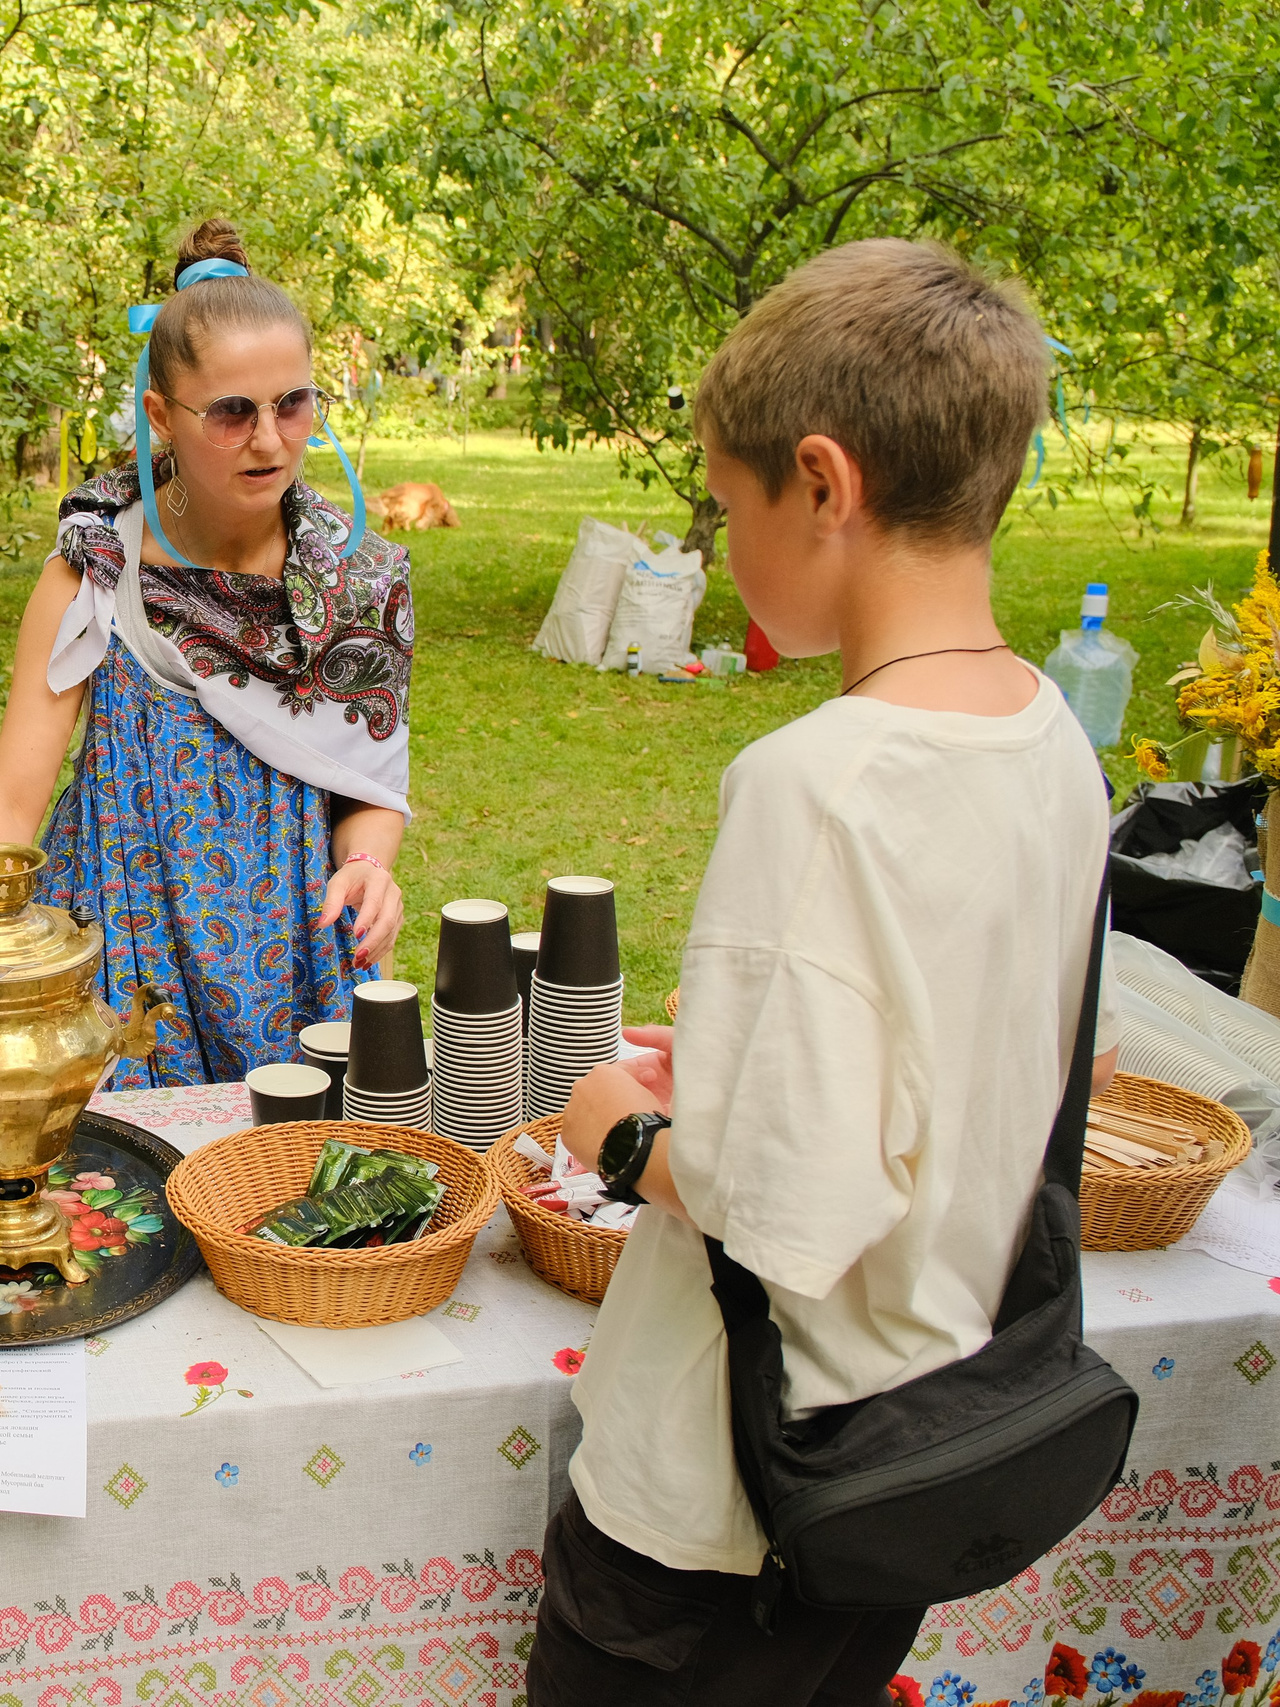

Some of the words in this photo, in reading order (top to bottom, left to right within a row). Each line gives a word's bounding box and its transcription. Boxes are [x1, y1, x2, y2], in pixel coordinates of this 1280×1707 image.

[1, 1470, 36, 1478] Мобильный
[1, 1479, 33, 1487] Мусорный
[954, 1544, 1023, 1575] Kappa
